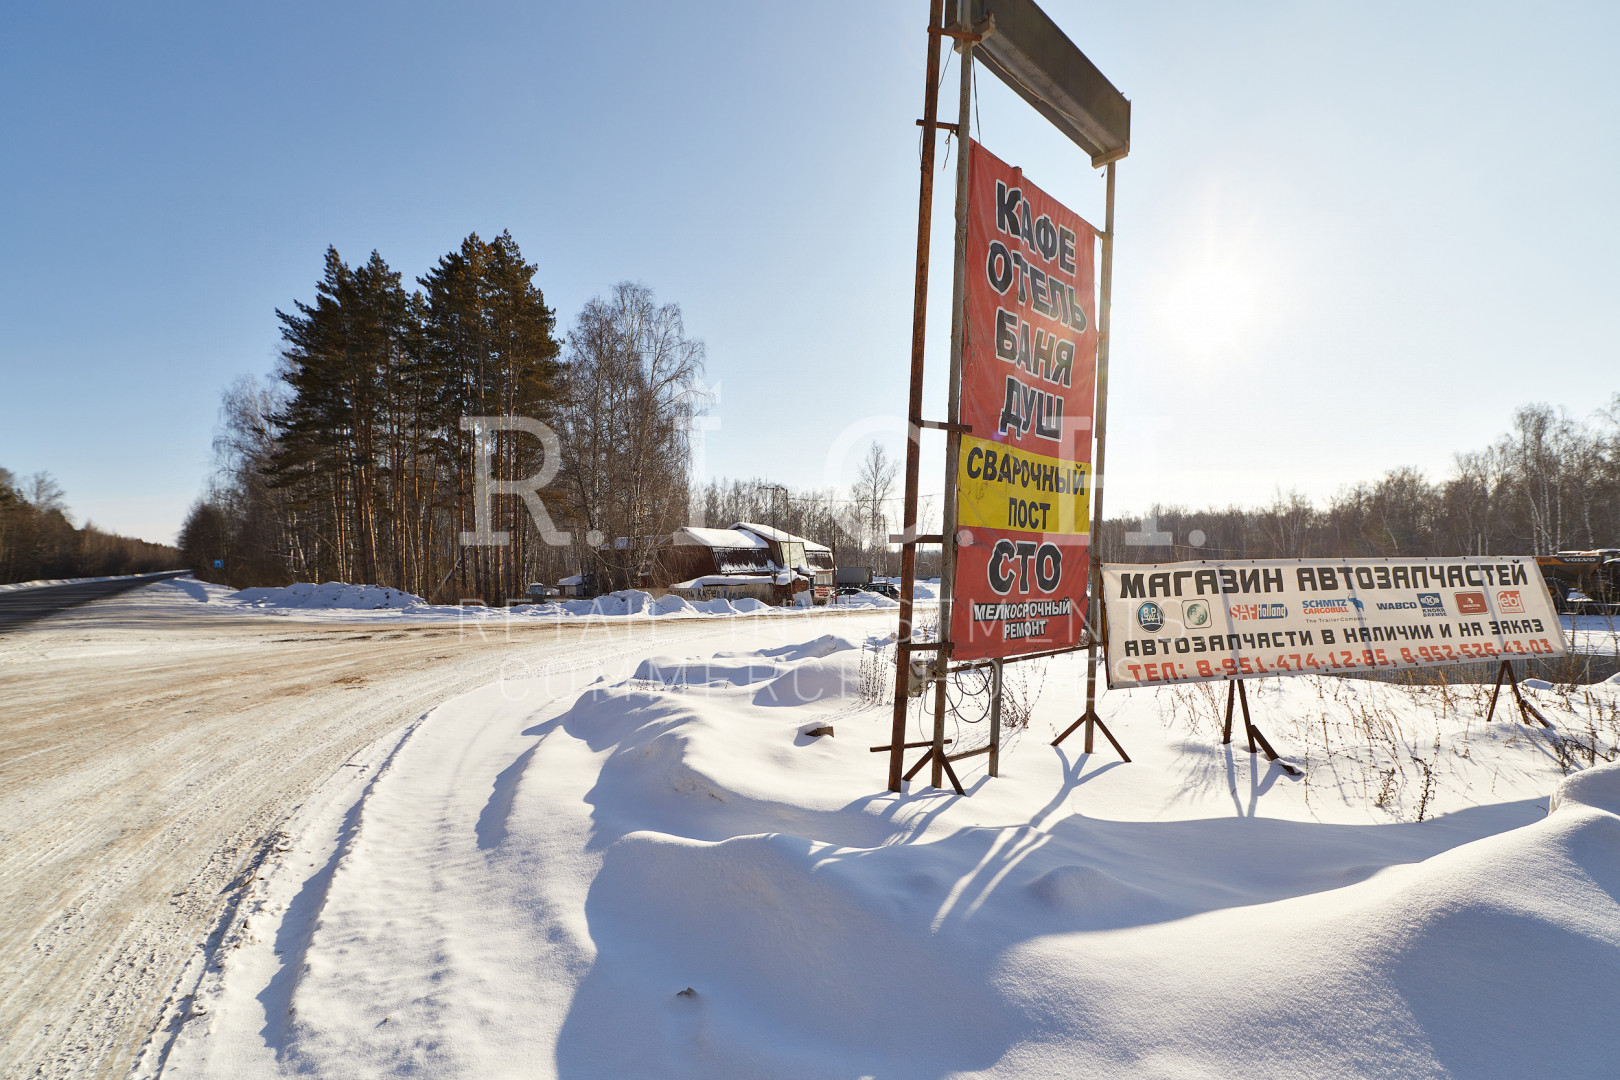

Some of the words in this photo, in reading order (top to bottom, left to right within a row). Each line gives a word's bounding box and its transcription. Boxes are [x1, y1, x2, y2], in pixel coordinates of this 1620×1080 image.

[995, 179, 1076, 276] КАФЕ
[986, 240, 1087, 333] ОТЕЛЬ
[995, 306, 1075, 388] БАНЯ
[998, 375, 1064, 442] ДУШ
[966, 446, 1086, 496] СВАРОЧНЫЙ
[1008, 497, 1051, 530] ПОСТ
[987, 538, 1063, 595] СТО
[1120, 568, 1284, 599] МАГАЗИН
[1296, 559, 1529, 592] АВТОЗАПЧАСТЕЙ
[972, 598, 1072, 621] МЕЛКОСРОЧНЫЙ
[1230, 604, 1258, 620] SAF
[1302, 599, 1347, 609] SCHMITZ
[1303, 607, 1349, 615] CARGOBULL
[1376, 601, 1418, 610] WABCO
[1498, 591, 1520, 606] febi
[1003, 620, 1047, 640] РЕМОНТ
[1124, 629, 1314, 657] АВТОЗАПЧАСТИ
[1321, 629, 1336, 644] В
[1343, 624, 1434, 643] НАЛИЧИИ
[1439, 624, 1452, 638] И
[1459, 622, 1484, 637] НА
[1489, 618, 1544, 635] ЗАКАЗ
